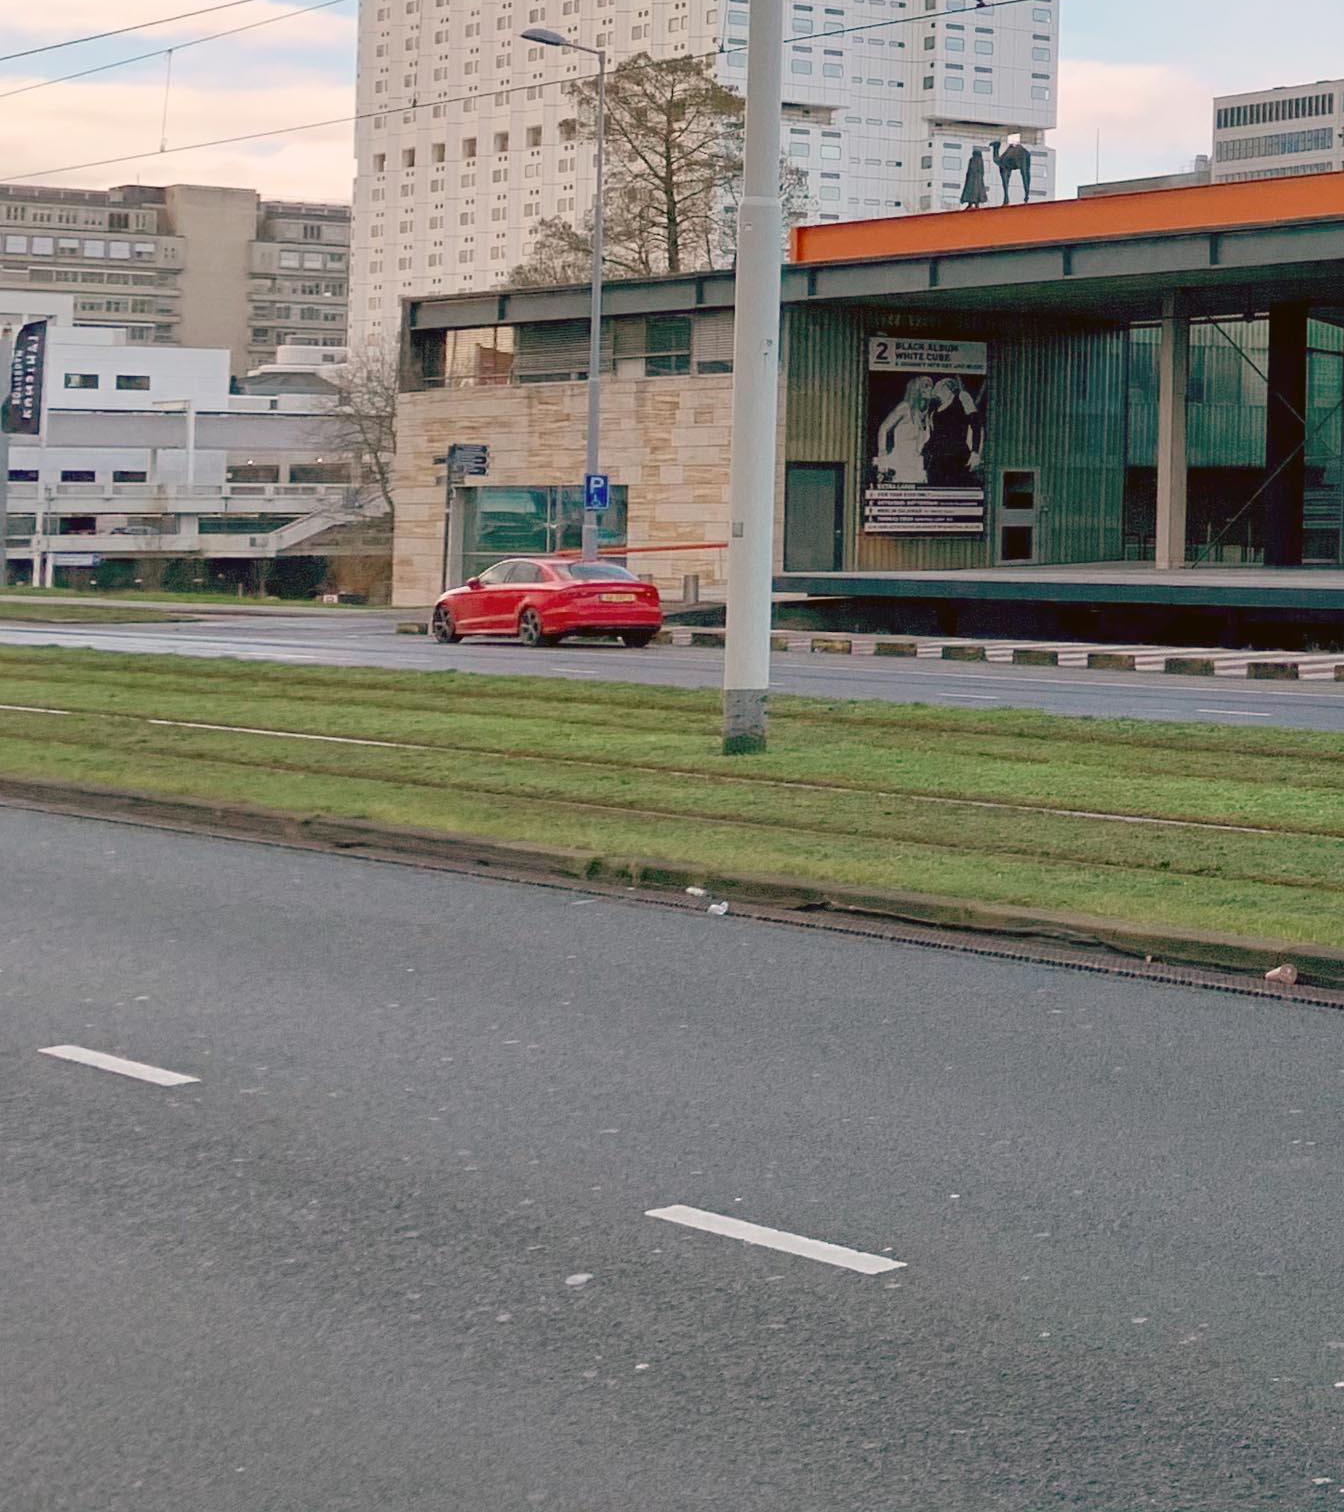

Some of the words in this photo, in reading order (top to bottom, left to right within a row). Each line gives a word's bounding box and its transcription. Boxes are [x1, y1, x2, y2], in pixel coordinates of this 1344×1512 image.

[876, 342, 888, 360] 2
[895, 352, 925, 361] WHITE
[926, 353, 951, 362] CUBE
[591, 477, 605, 493] P
